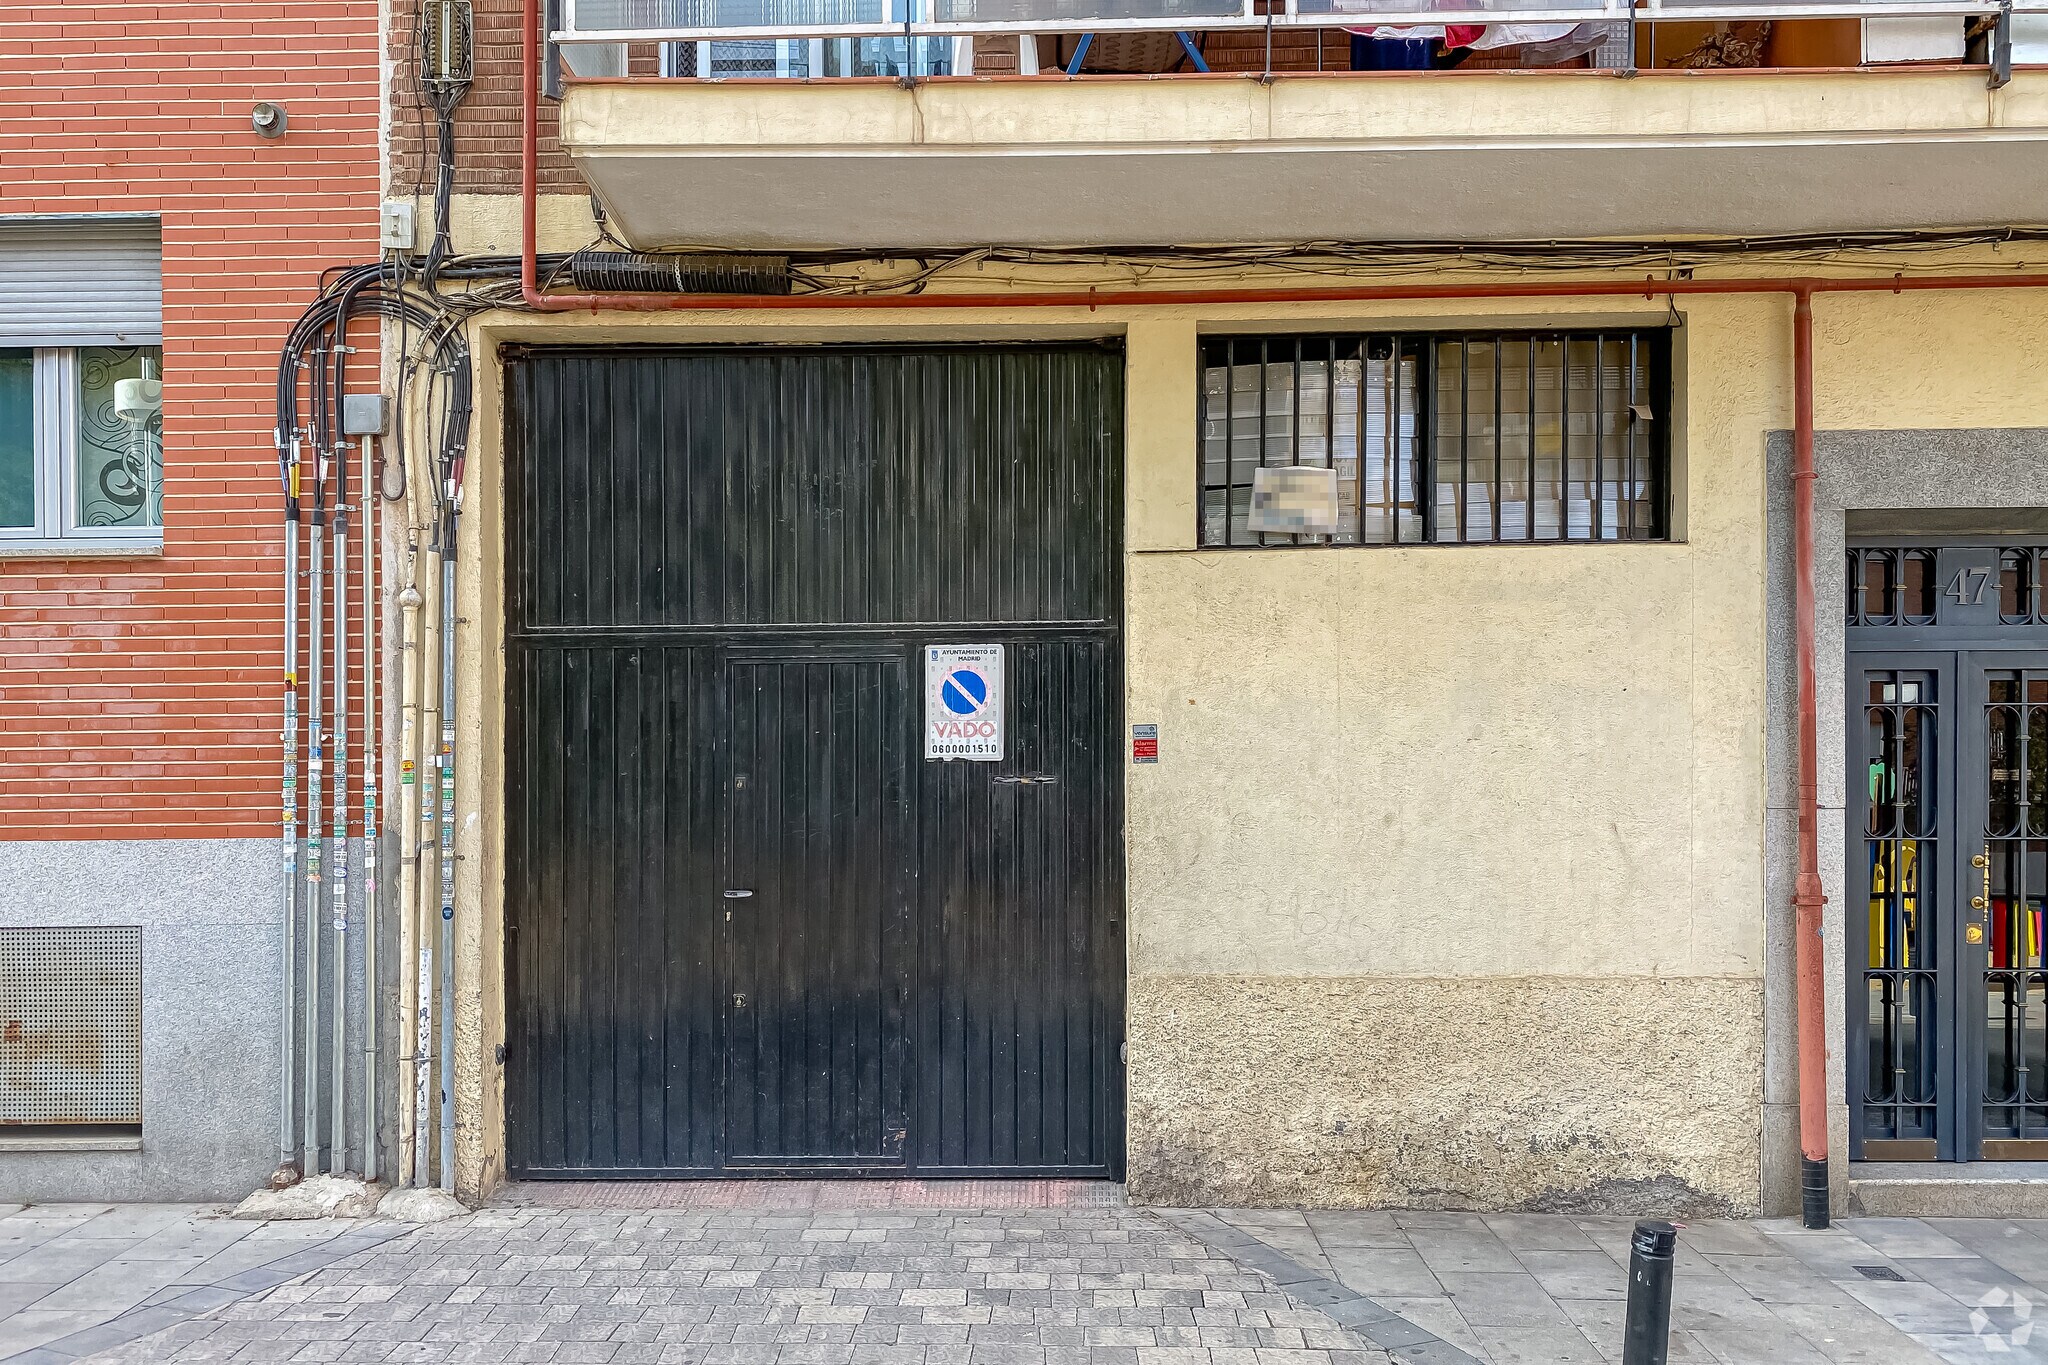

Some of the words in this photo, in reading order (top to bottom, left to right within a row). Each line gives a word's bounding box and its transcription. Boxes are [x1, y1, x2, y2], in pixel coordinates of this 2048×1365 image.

[1944, 566, 1991, 606] 47
[934, 722, 995, 738] VADO
[932, 744, 997, 754] 0600001510
